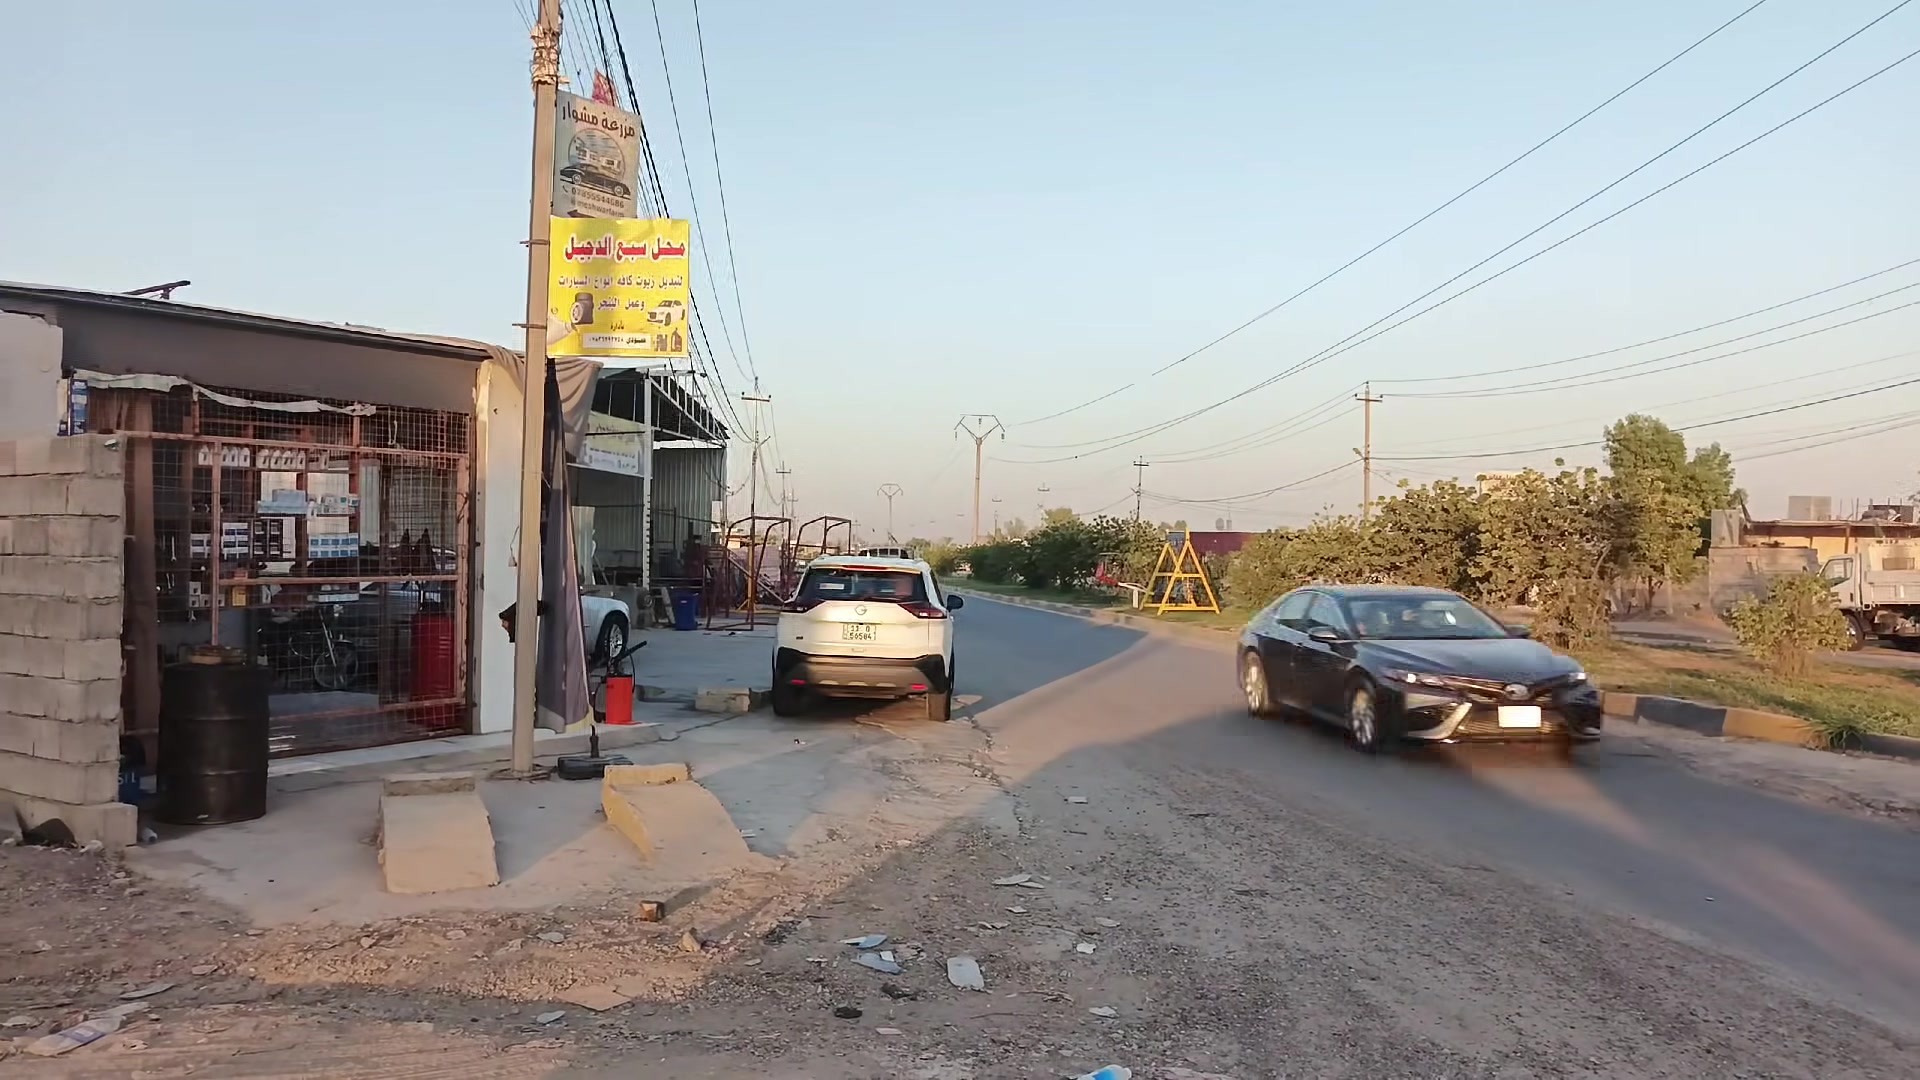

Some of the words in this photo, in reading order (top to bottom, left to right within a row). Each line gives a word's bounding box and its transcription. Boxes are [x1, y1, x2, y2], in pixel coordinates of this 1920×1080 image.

[562, 101, 598, 125] مشوار
[602, 111, 635, 138] مزرعة
[565, 236, 612, 260] الدجيل
[615, 241, 647, 261] سبع
[651, 236, 686, 260] محل
